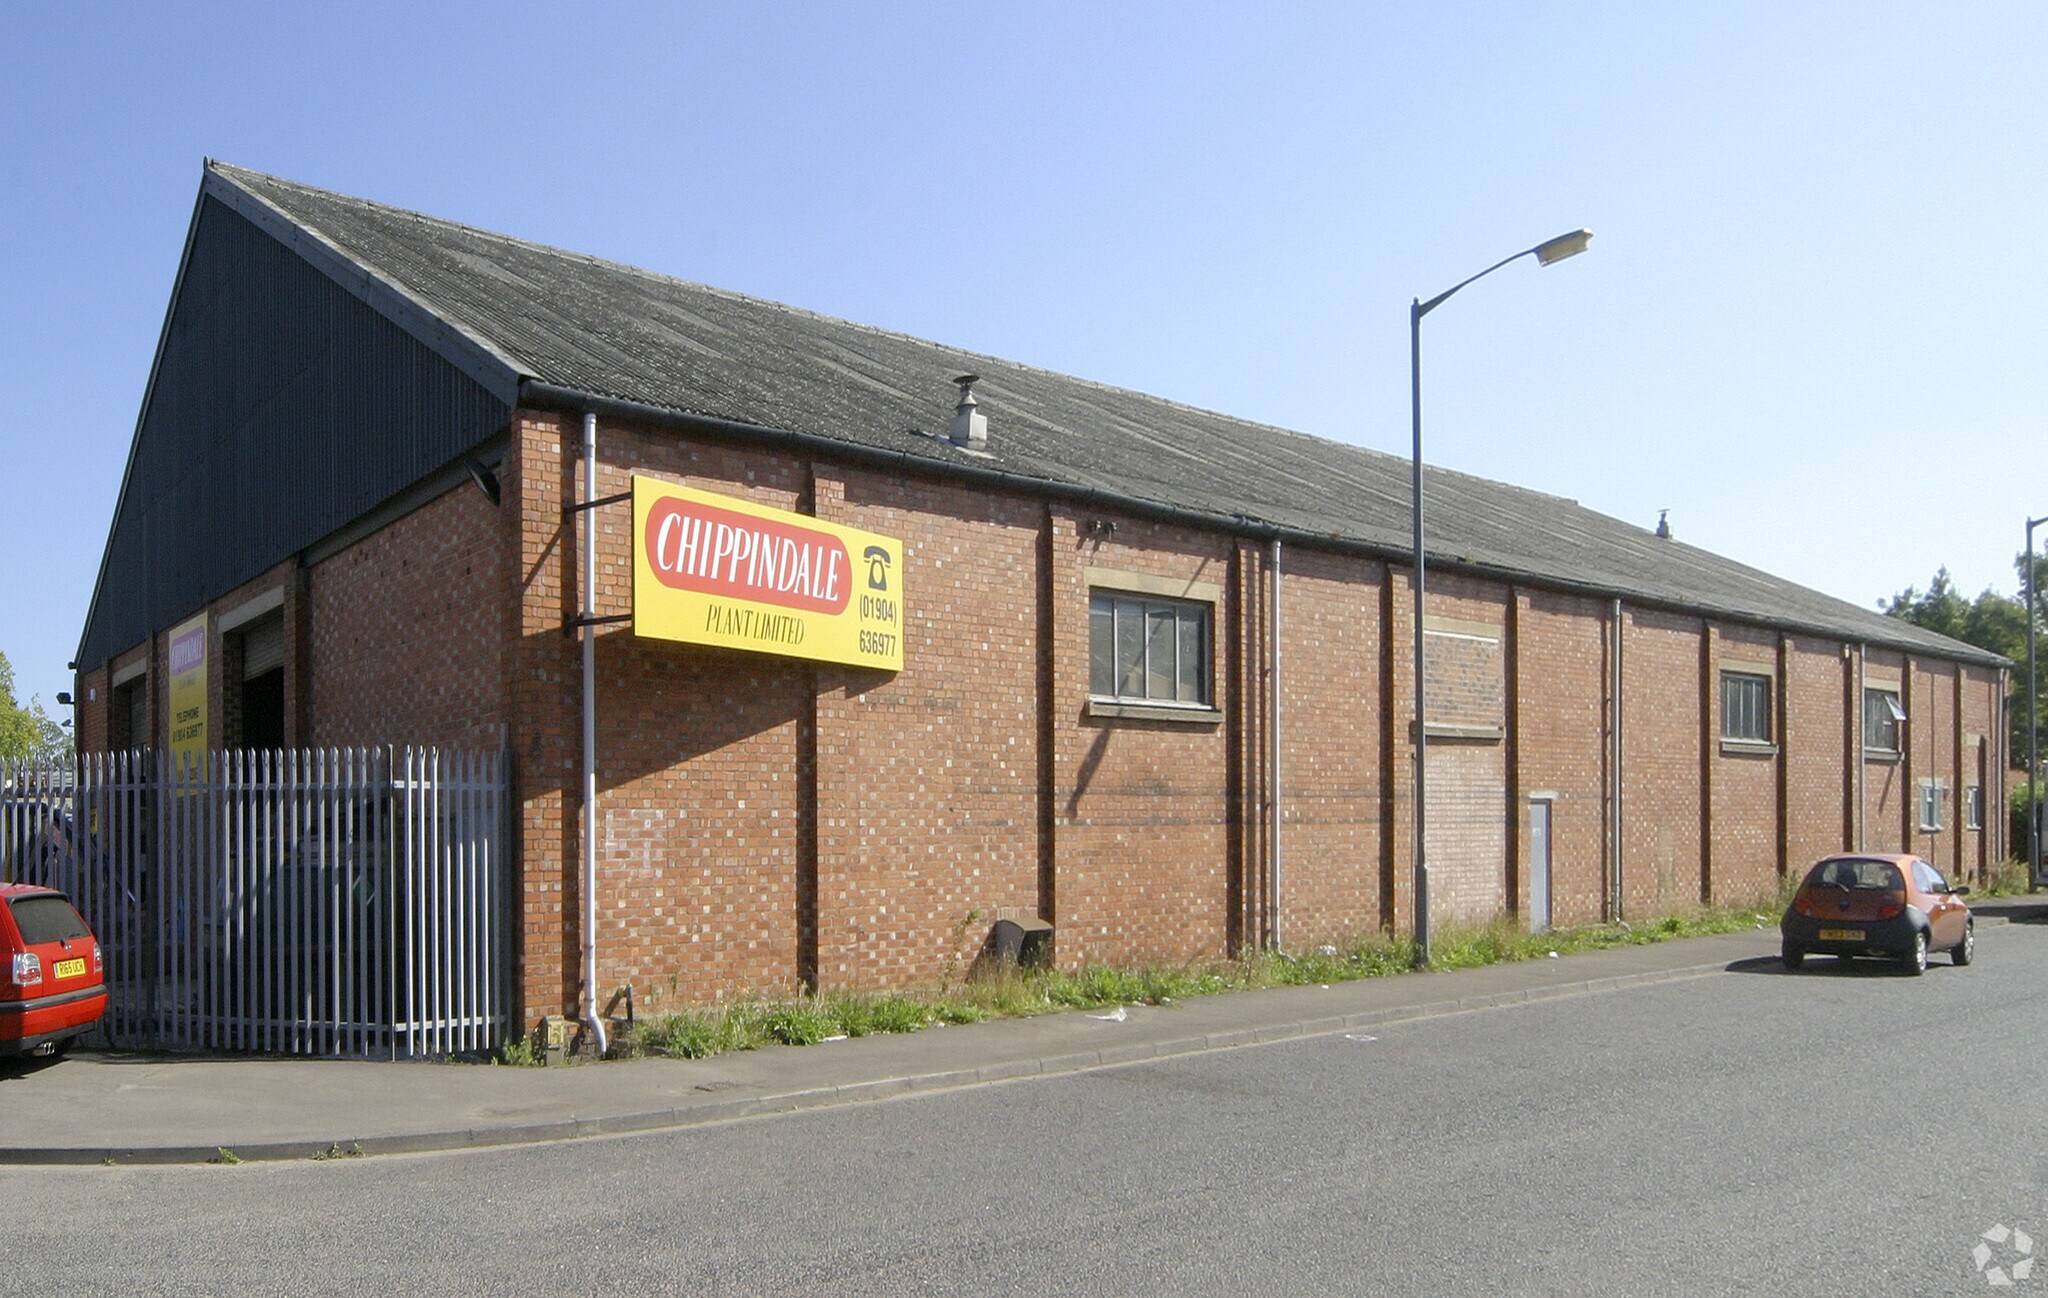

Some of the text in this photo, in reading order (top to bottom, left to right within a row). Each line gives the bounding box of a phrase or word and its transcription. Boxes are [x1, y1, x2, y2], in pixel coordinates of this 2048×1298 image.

[657, 512, 842, 601] CHIPPINDALE
[706, 604, 805, 645] PLANT LIMITED
[860, 593, 897, 629] (01904)
[860, 629, 896, 657] 636977
[176, 706, 200, 723] TELEPHONE
